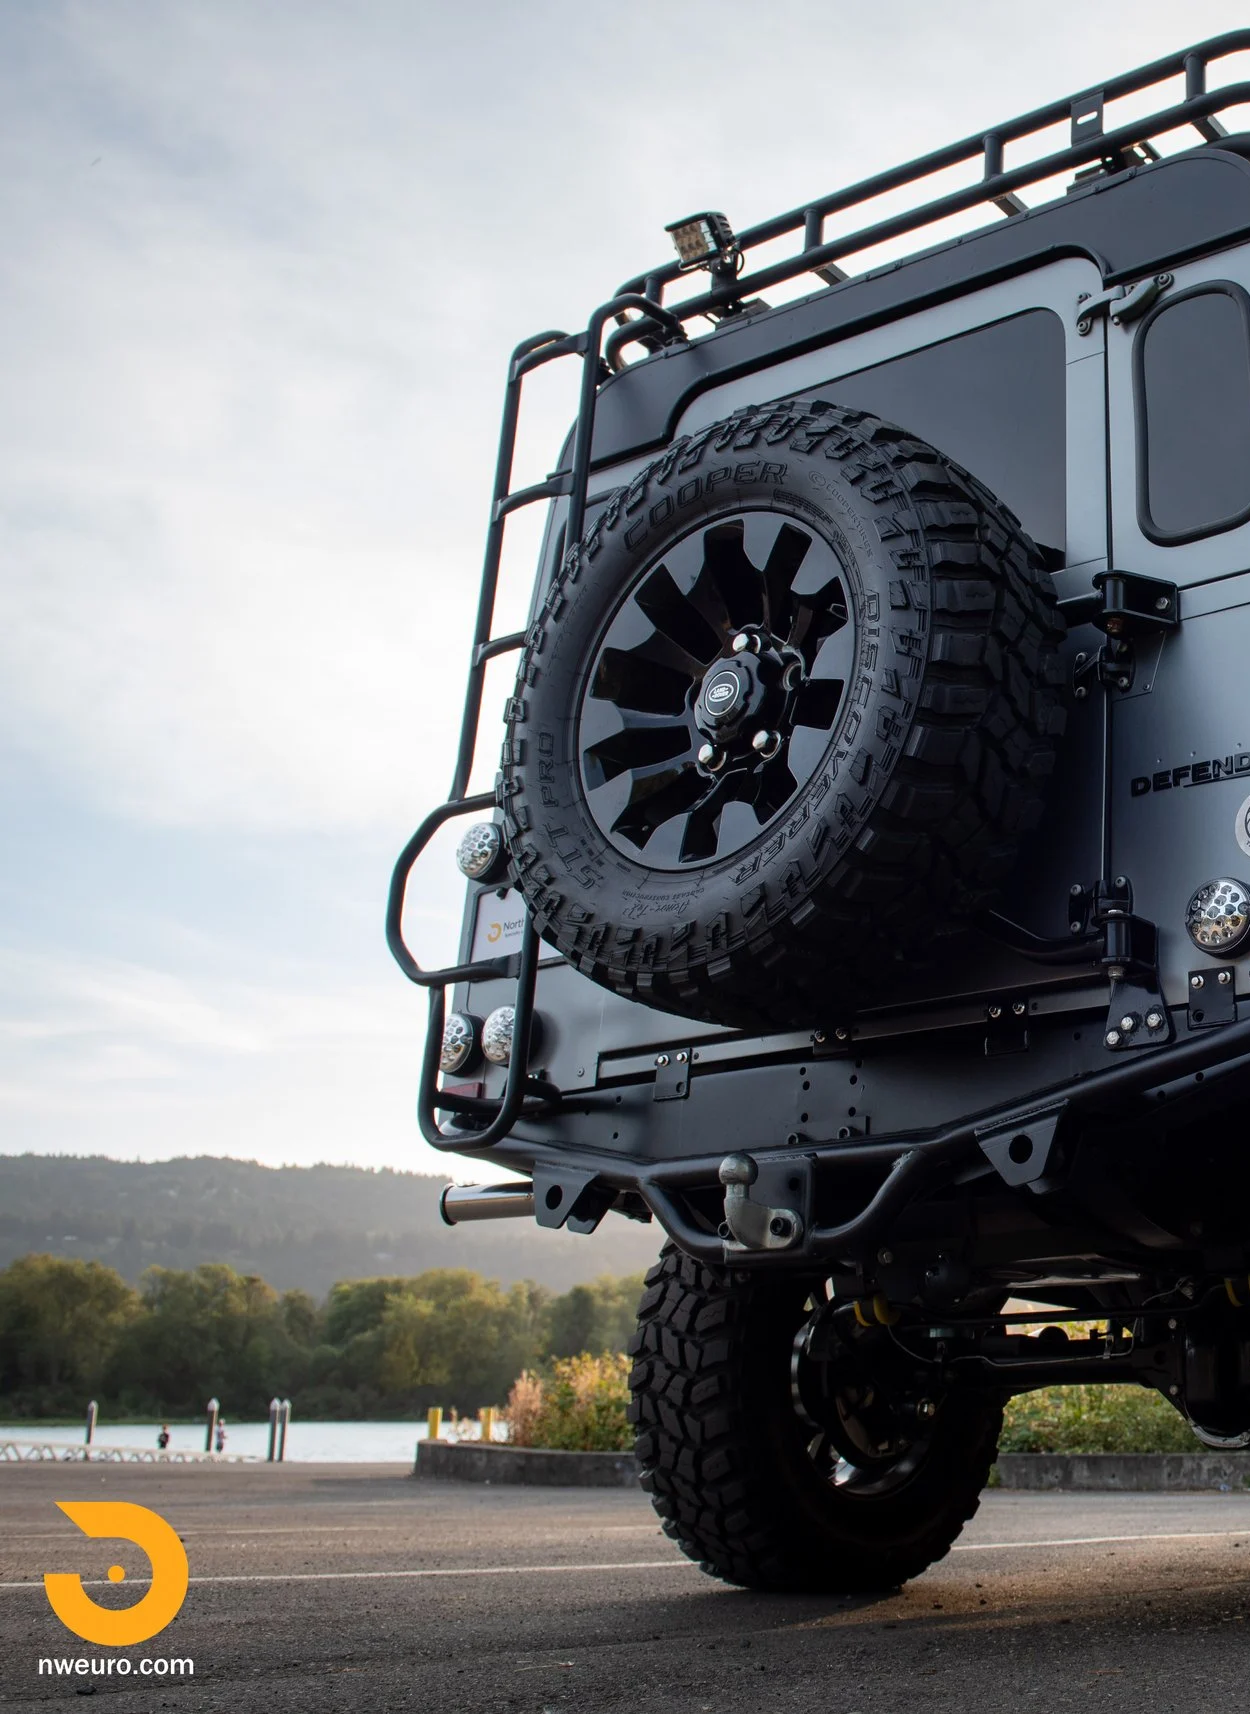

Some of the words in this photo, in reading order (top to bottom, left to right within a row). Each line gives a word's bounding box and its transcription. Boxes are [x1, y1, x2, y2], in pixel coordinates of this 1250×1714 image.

[624, 461, 787, 551] COOPER
[538, 731, 559, 808] PRO
[732, 590, 882, 886] DISCOVERER
[543, 822, 605, 890] STT
